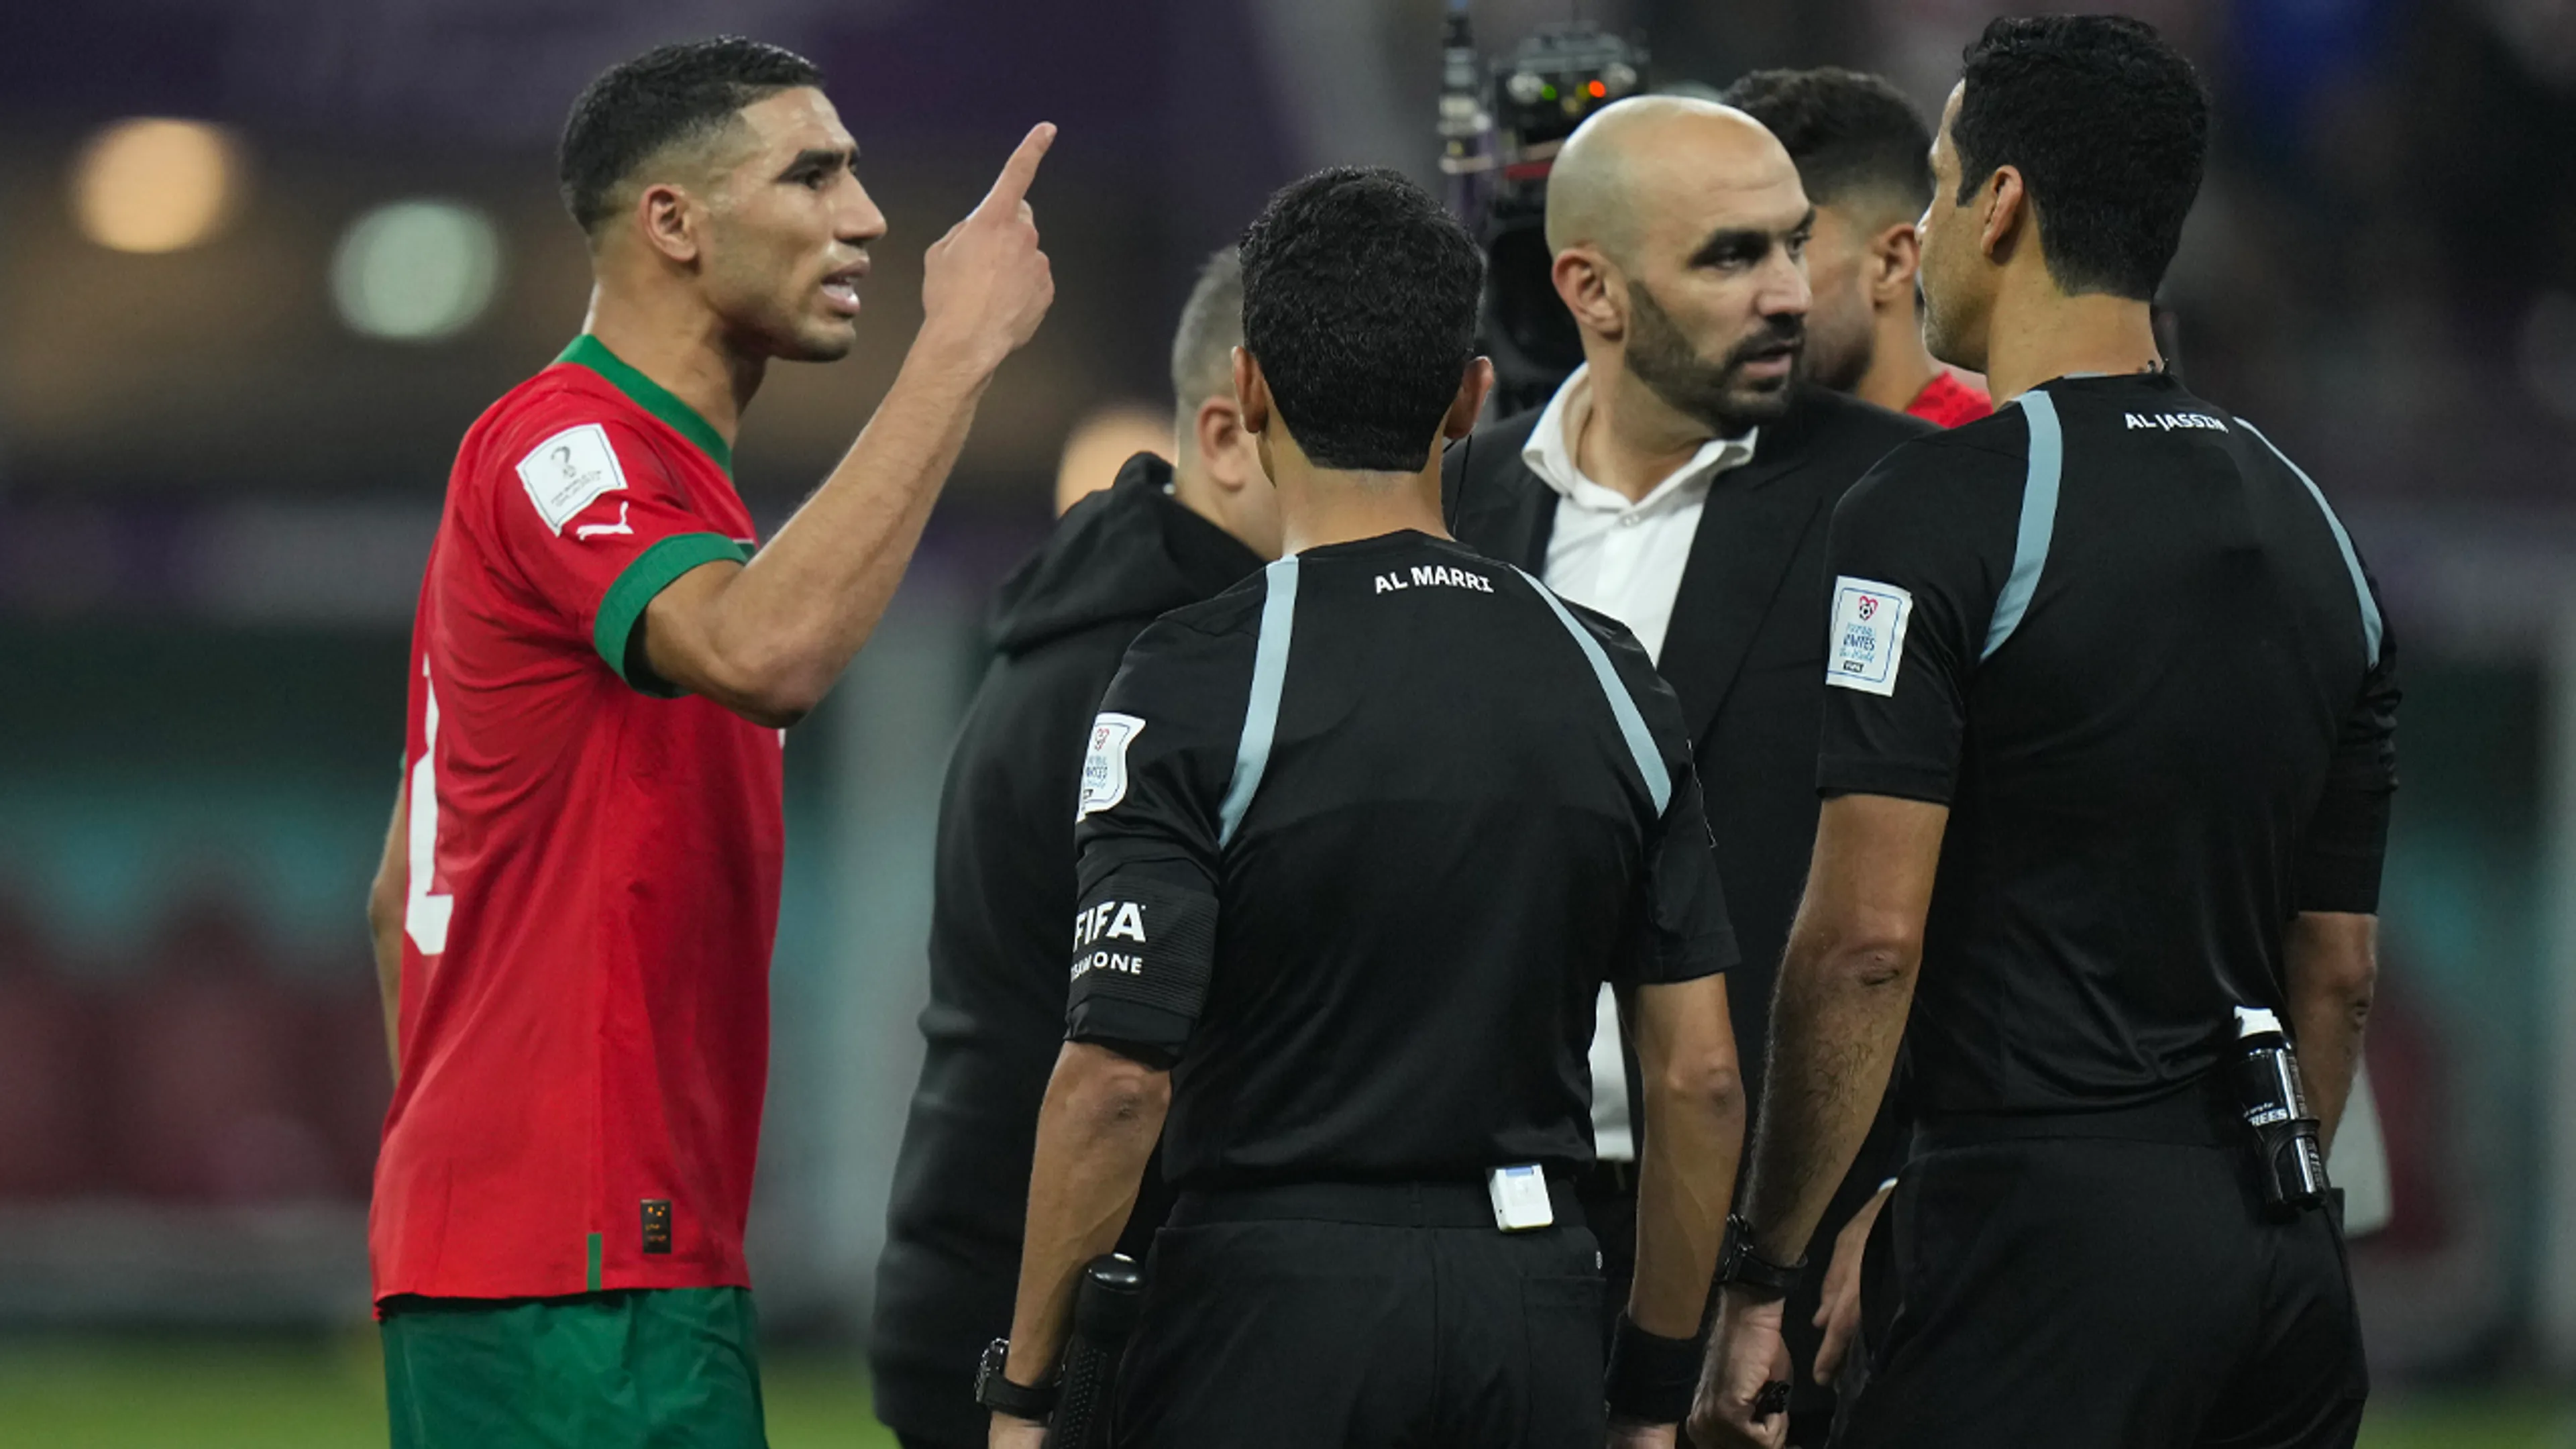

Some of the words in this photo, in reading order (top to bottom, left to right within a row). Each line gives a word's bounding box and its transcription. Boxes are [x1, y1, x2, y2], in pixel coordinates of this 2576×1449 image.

[2125, 412, 2157, 430] AL
[1375, 572, 1408, 594] AL
[1410, 565, 1495, 593] MARRI
[1073, 901, 1146, 953] FIFA
